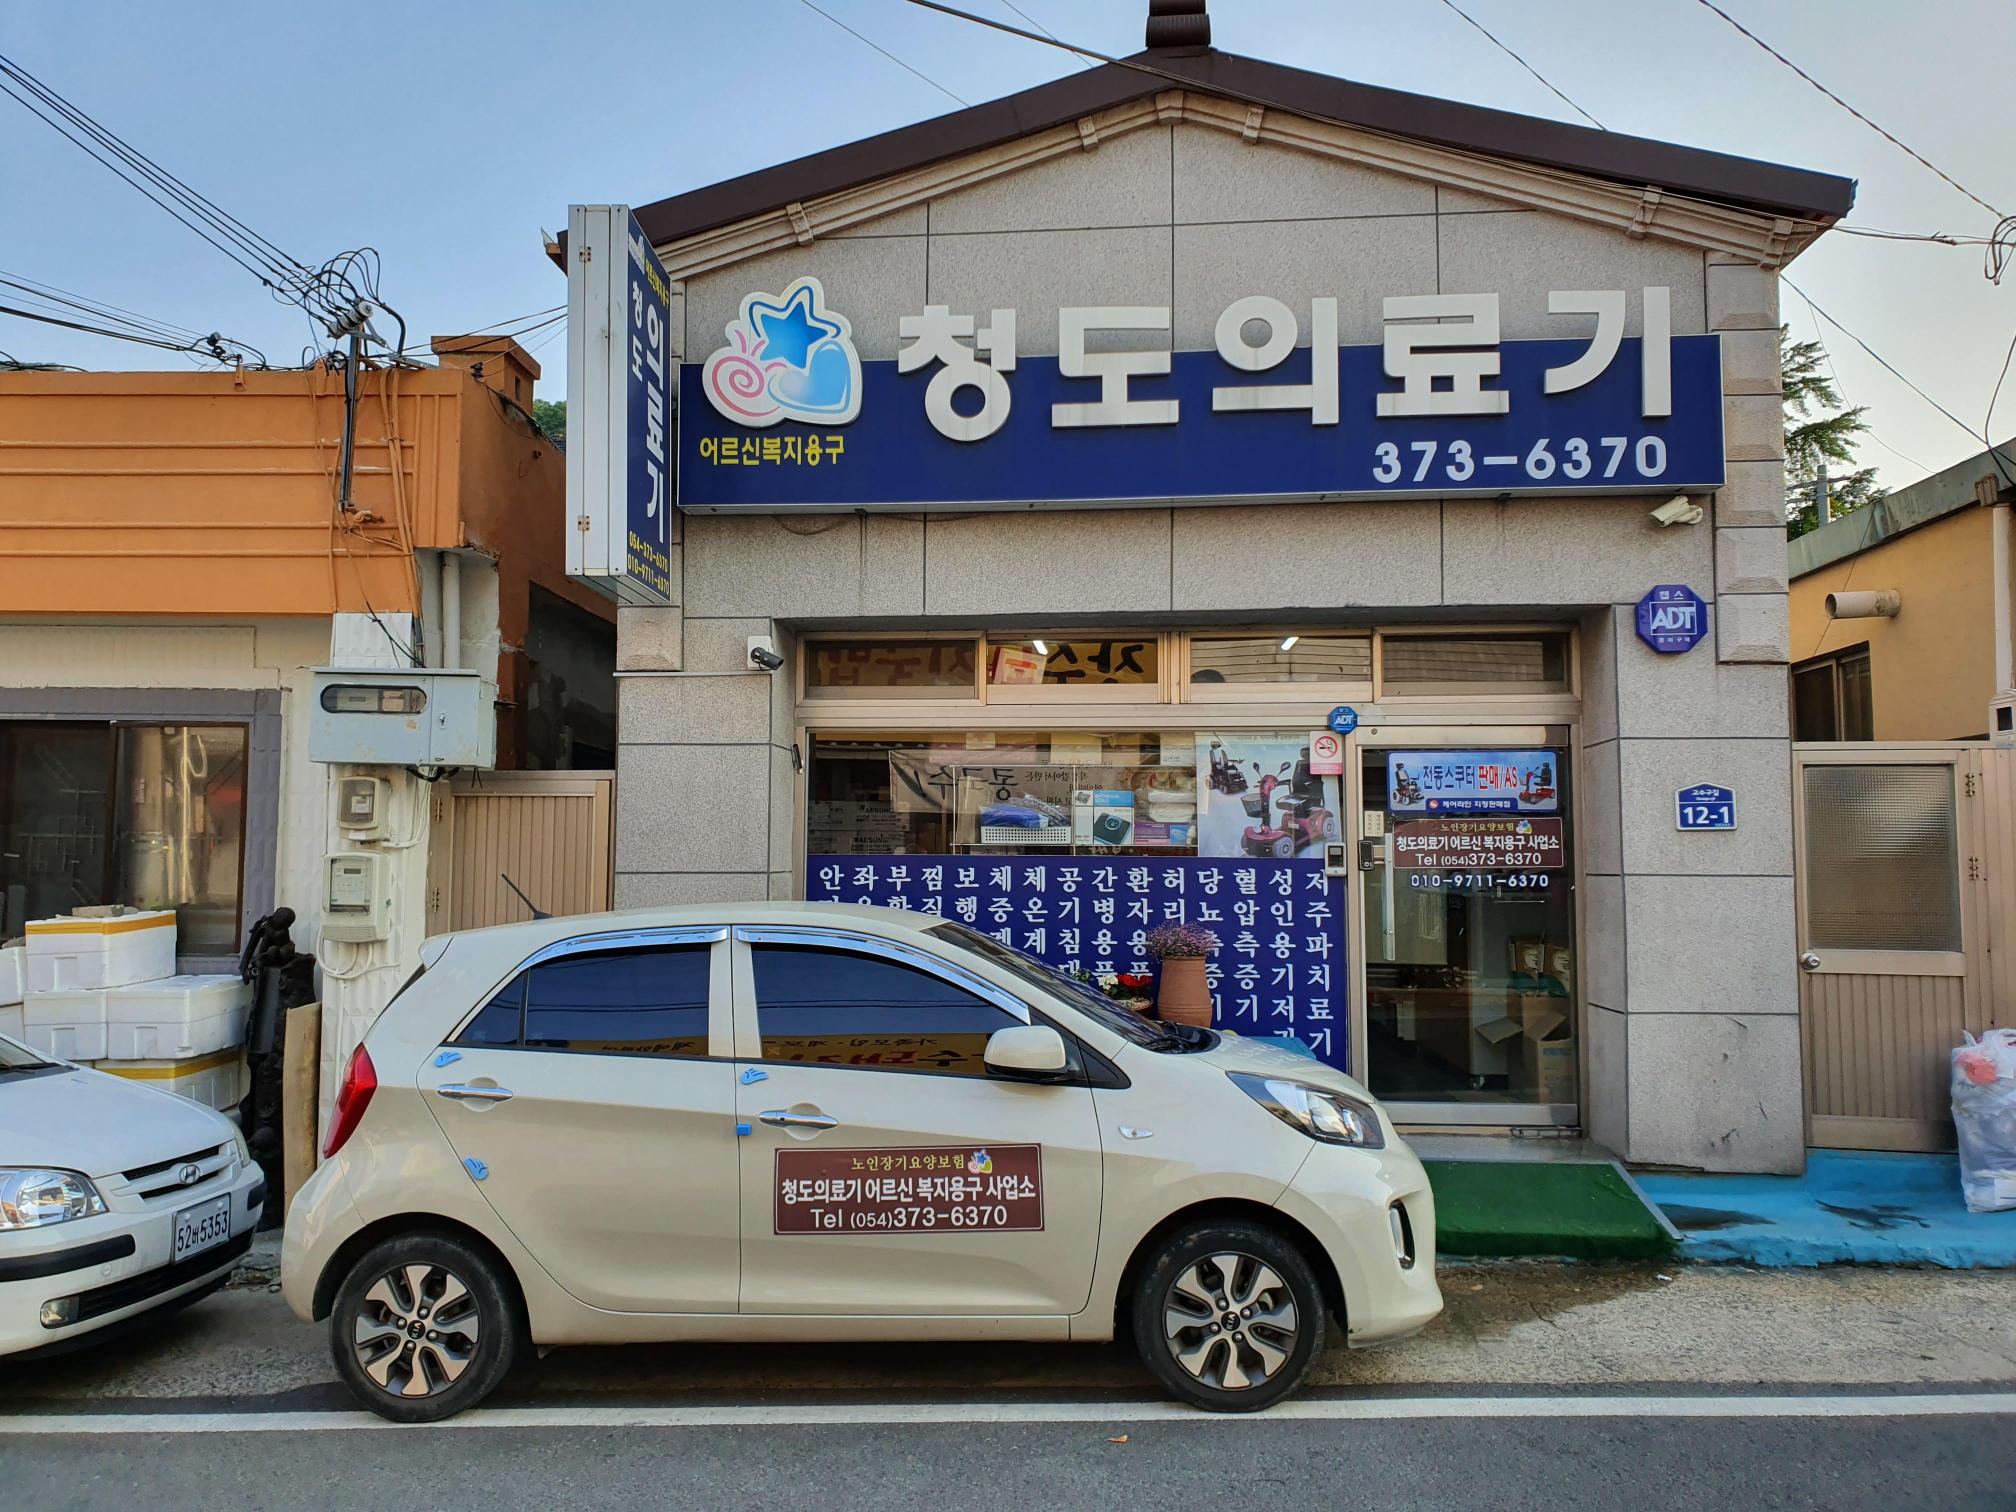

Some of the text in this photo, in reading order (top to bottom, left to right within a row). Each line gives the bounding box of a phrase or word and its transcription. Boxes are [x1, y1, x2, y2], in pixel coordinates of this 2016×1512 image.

[632, 280, 643, 382] 청도
[897, 286, 1672, 442] 청도의료기
[646, 303, 664, 544] 의료기
[699, 434, 845, 467] 어르신복지용구
[1373, 435, 1668, 484] 373-6370
[629, 530, 668, 574] 054-373-6370
[1651, 606, 1696, 630] ADT
[1334, 714, 1353, 725] ADT
[1422, 764, 1518, 791] 전동스쿠터 판매/AS
[1440, 822, 1514, 832] 노인장기요양보험
[1682, 805, 1729, 825] 12-1
[1397, 835, 1560, 851] 청도의료기 어르신 복지용구 사업소
[1416, 853, 1542, 866] Tel (054)373-6370
[1411, 874, 1549, 888] 010-9711-6370
[1304, 869, 1334, 1057] 저주파치료기
[851, 1153, 965, 1171] 노인장기요양보험
[781, 1174, 1036, 1205] 청도의료기 어르신 복지용구 사업소
[811, 1205, 1008, 1230] Tel (054)373-6370
